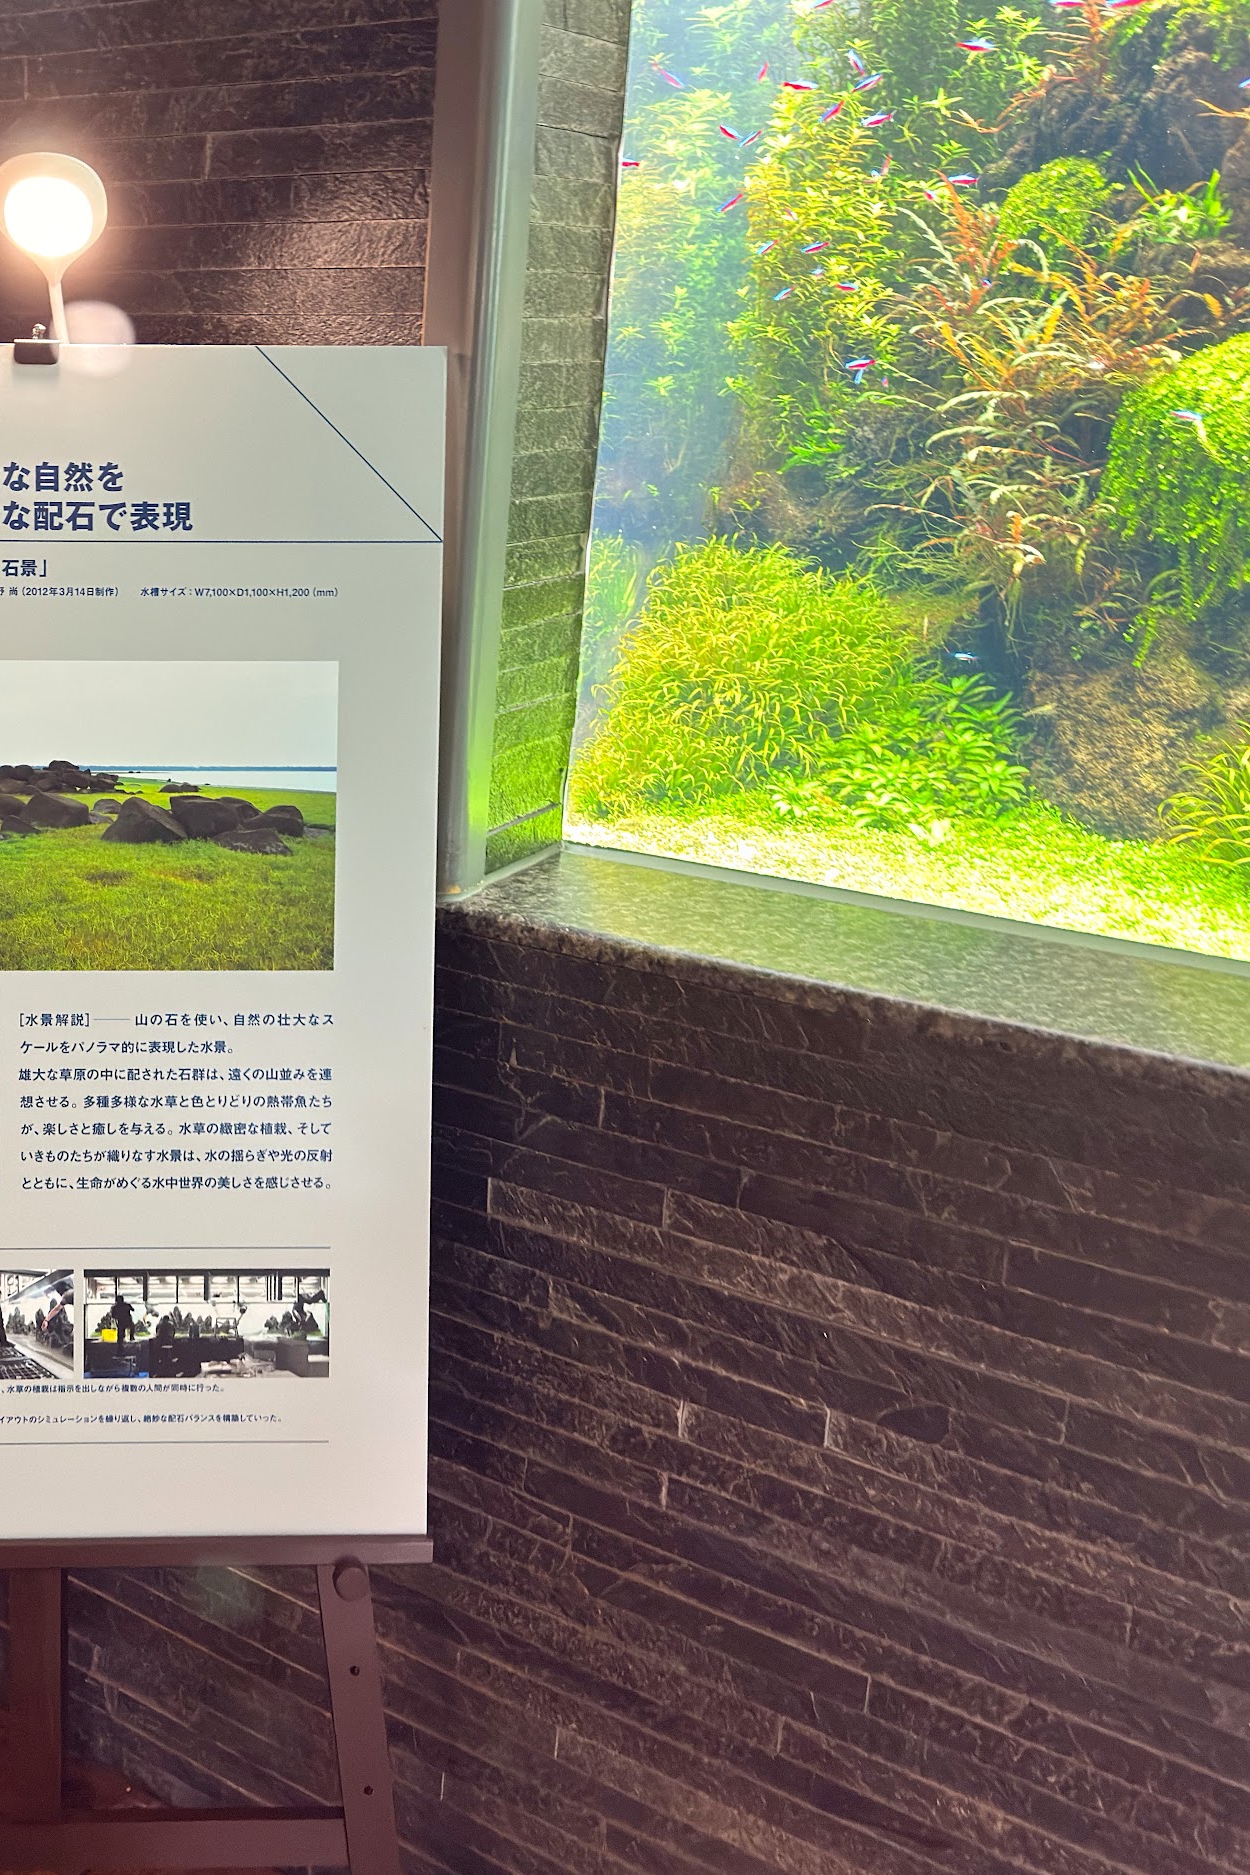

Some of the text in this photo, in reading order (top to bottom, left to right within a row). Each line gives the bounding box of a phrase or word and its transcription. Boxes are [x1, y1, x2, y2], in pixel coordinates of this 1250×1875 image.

[20, 1041, 234, 1054] ケールをパノラマ的に表現した水景。
[18, 1068, 333, 1082] 雄大な草原の中に配された石群は、遠くの山並みを連
[20, 1095, 333, 1109] 想させる。多種多様な水草と色とりどりの熱帯魚たち
[20, 1149, 333, 1163] いきものたちが織りなす水景は、水の揺らぎや光の反射
[21, 1176, 332, 1190] とともに、生命がめぐる水中世界の美しさを感じさせる。
